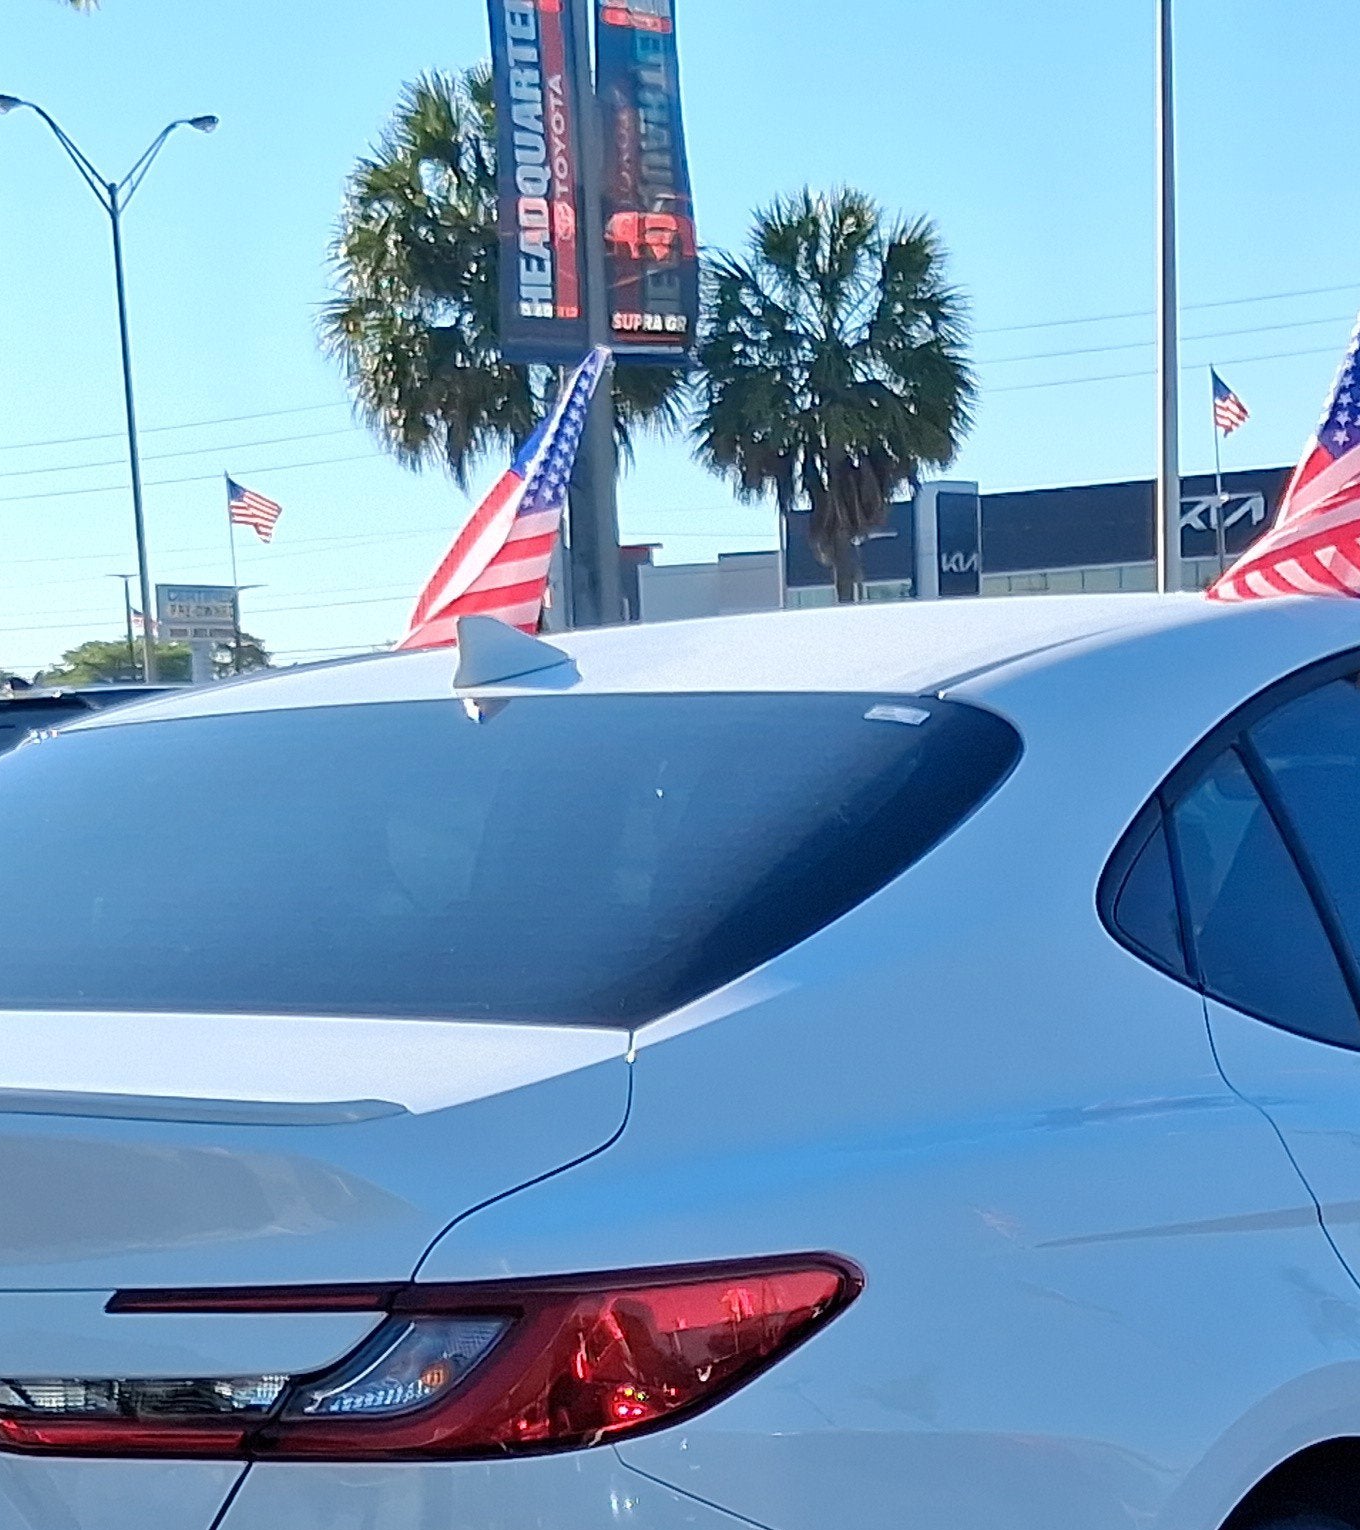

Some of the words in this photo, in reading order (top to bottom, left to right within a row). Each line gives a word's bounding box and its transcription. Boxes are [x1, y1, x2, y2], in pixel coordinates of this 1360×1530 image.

[504, 0, 554, 305] HEADQUARTE
[548, 74, 570, 198] TOYOTA
[611, 312, 662, 332] SUPRA
